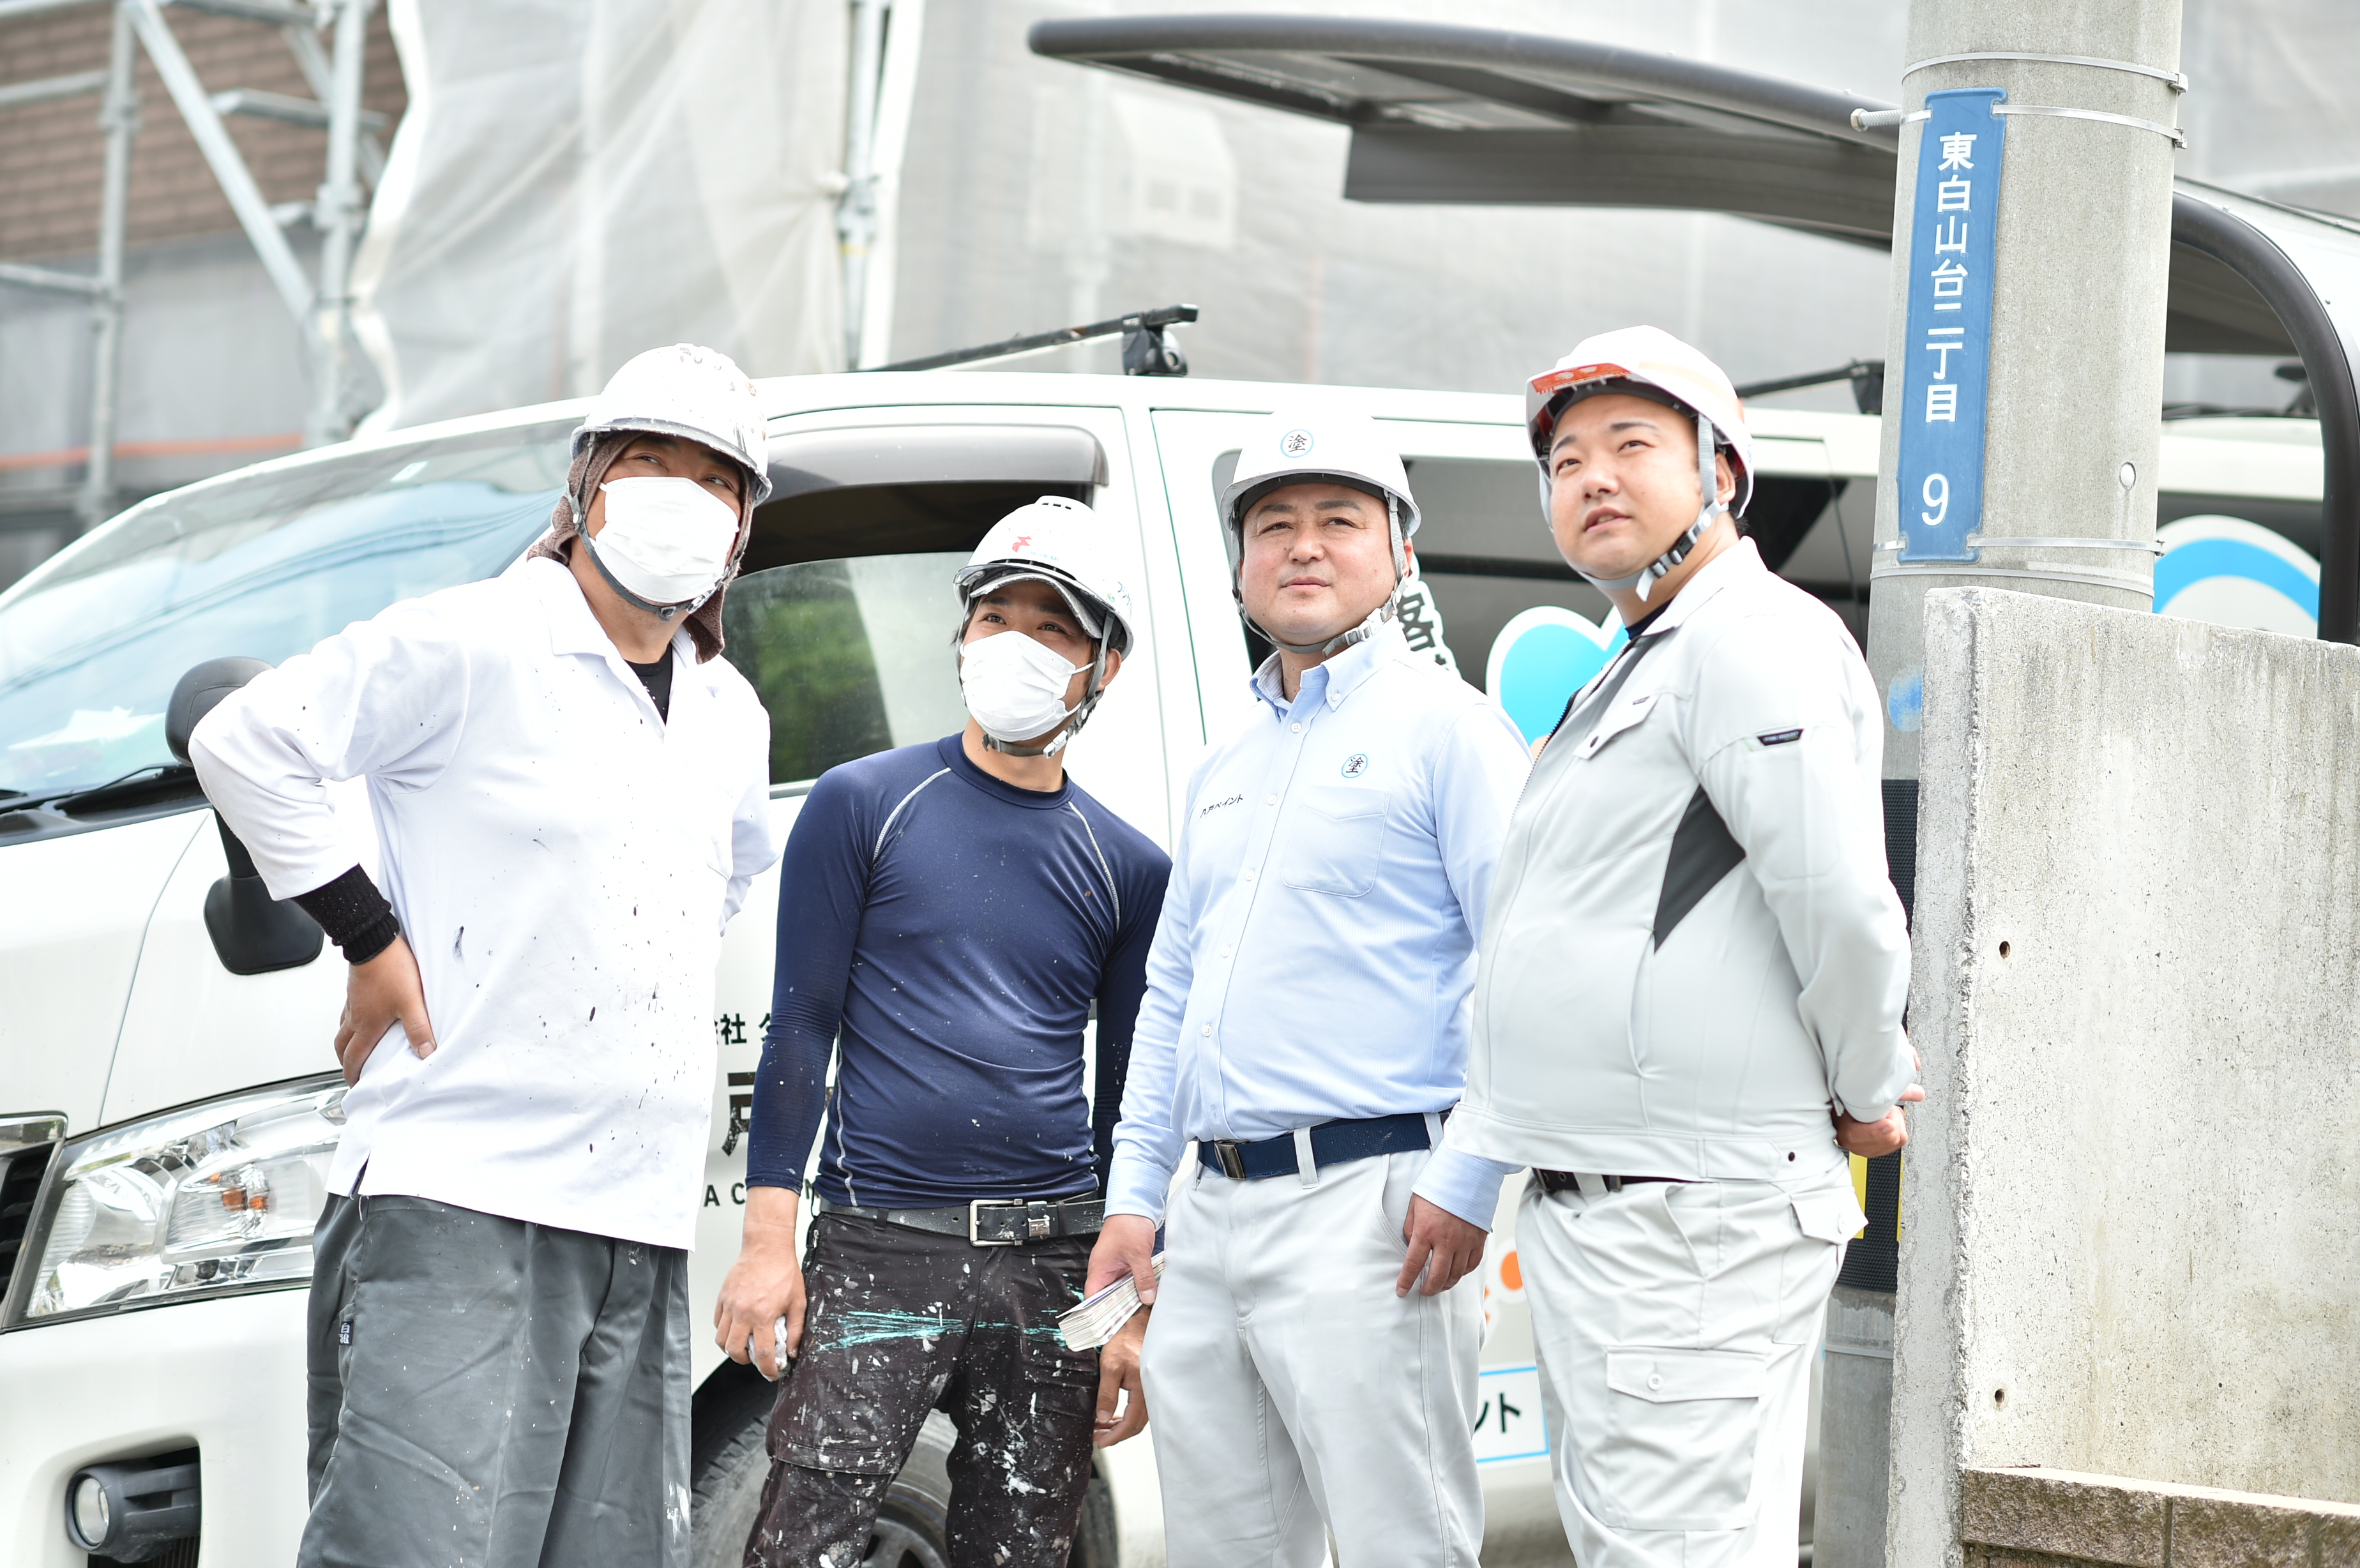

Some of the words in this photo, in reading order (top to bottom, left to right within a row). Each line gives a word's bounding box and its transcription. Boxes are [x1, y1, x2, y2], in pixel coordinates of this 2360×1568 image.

[1925, 131, 1978, 423] 東白山台二丁目
[1288, 434, 1308, 452] 塗
[1921, 473, 1949, 527] 9
[1345, 756, 1365, 774] 塗
